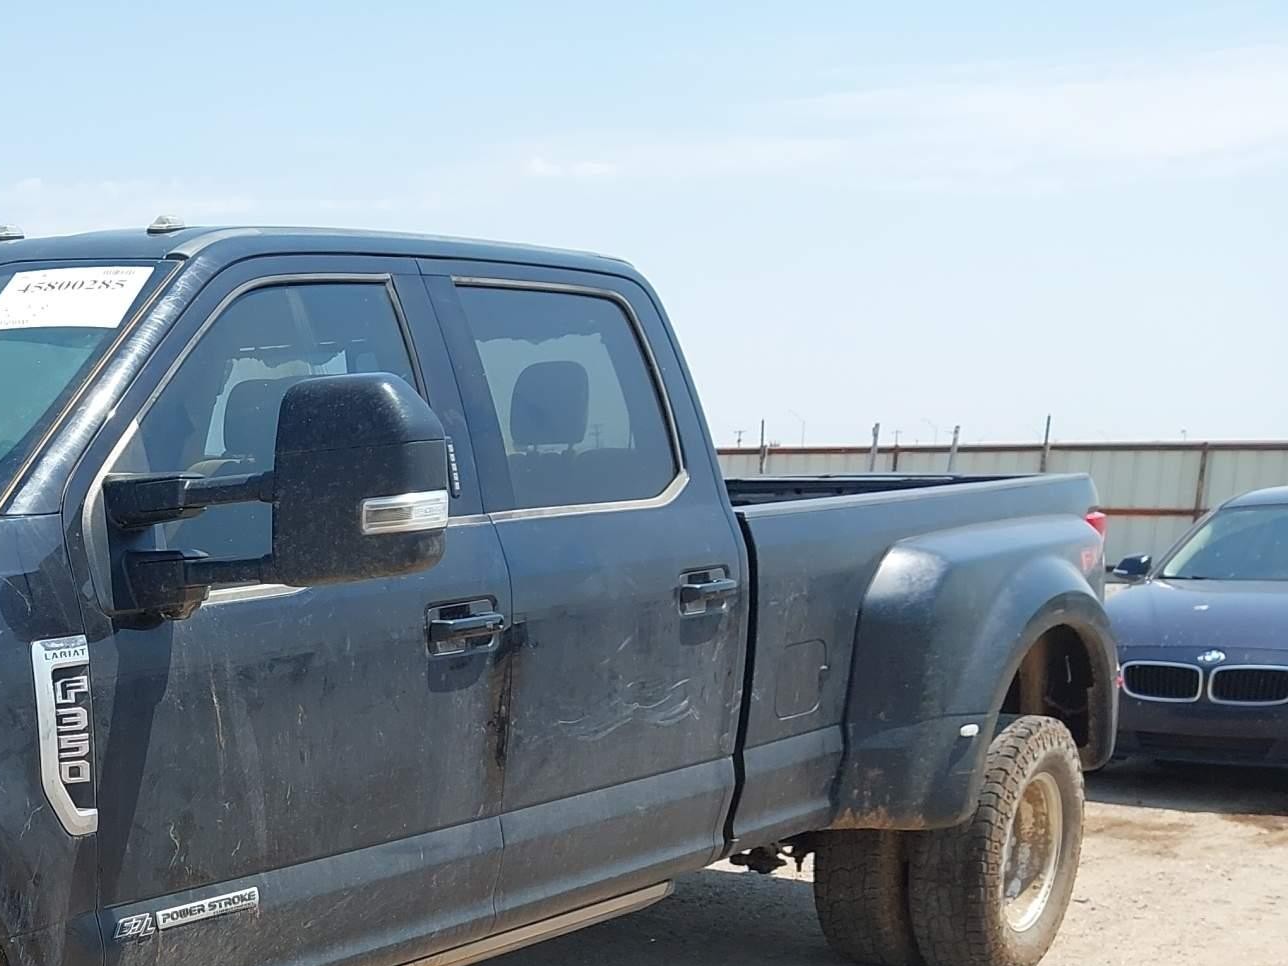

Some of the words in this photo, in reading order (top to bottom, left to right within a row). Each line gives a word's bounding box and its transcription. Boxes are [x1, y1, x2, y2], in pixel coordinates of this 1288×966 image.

[17, 278, 128, 295] 45800285
[44, 647, 87, 661] LARIAT
[54, 675, 91, 784] F350
[161, 903, 206, 924] POWER
[207, 890, 257, 912] STROKE
